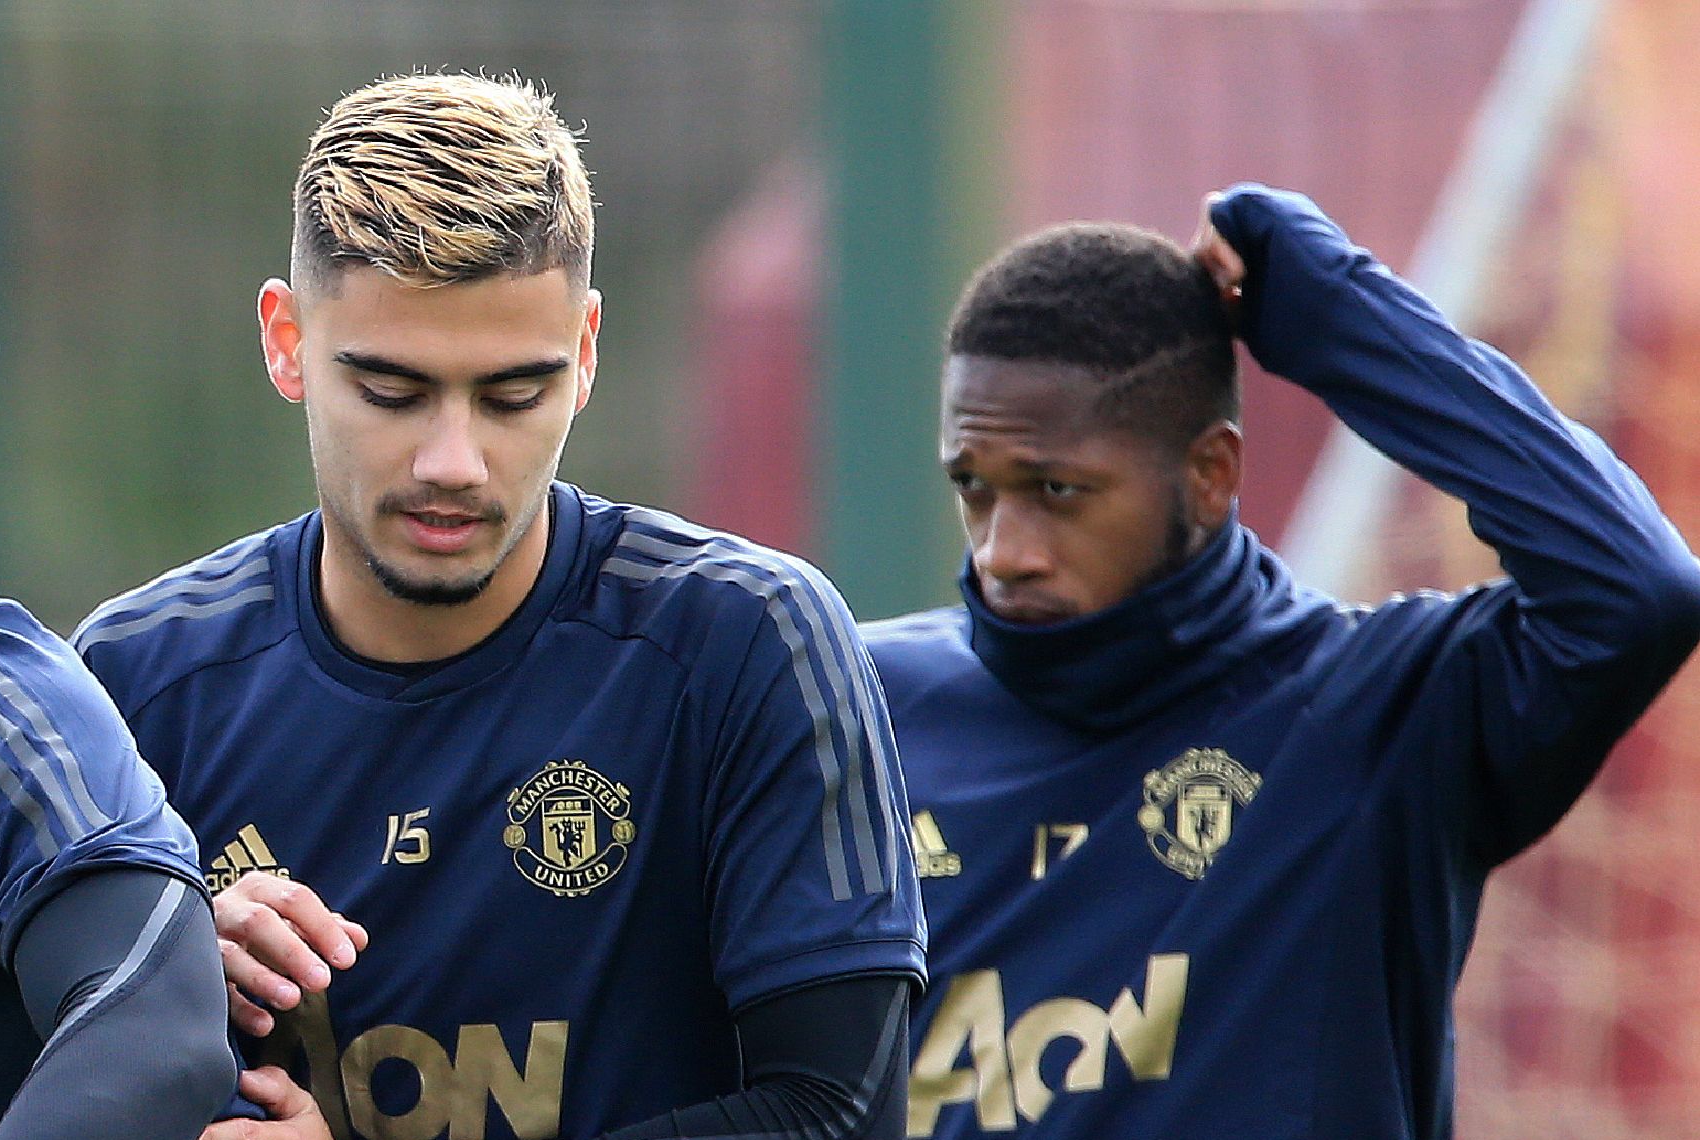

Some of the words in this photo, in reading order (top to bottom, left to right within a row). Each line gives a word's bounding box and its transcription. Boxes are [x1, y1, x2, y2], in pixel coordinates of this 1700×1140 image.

[515, 770, 621, 815] MANCHESTER
[381, 806, 431, 865] 15
[1031, 823, 1090, 880] 17
[534, 862, 610, 888] UNITED
